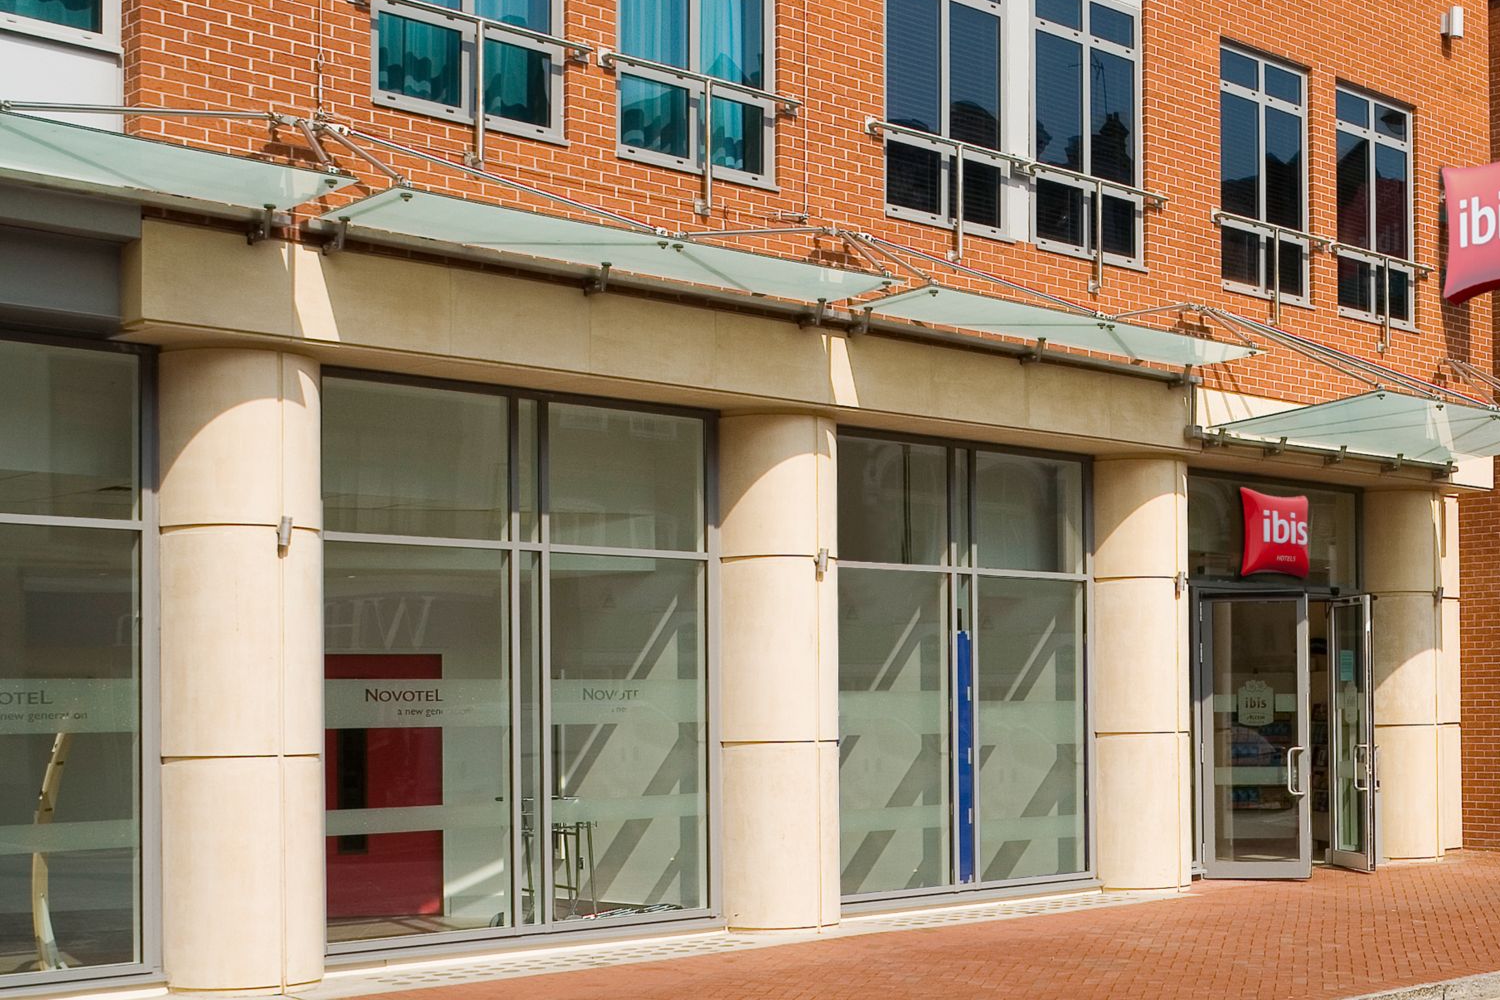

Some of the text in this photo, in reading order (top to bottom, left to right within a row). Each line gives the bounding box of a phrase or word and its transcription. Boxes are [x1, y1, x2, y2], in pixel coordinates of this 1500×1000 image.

[1263, 509, 1308, 545] ibis
[365, 688, 444, 702] NOVOTEL
[1245, 697, 1267, 709] ibis
